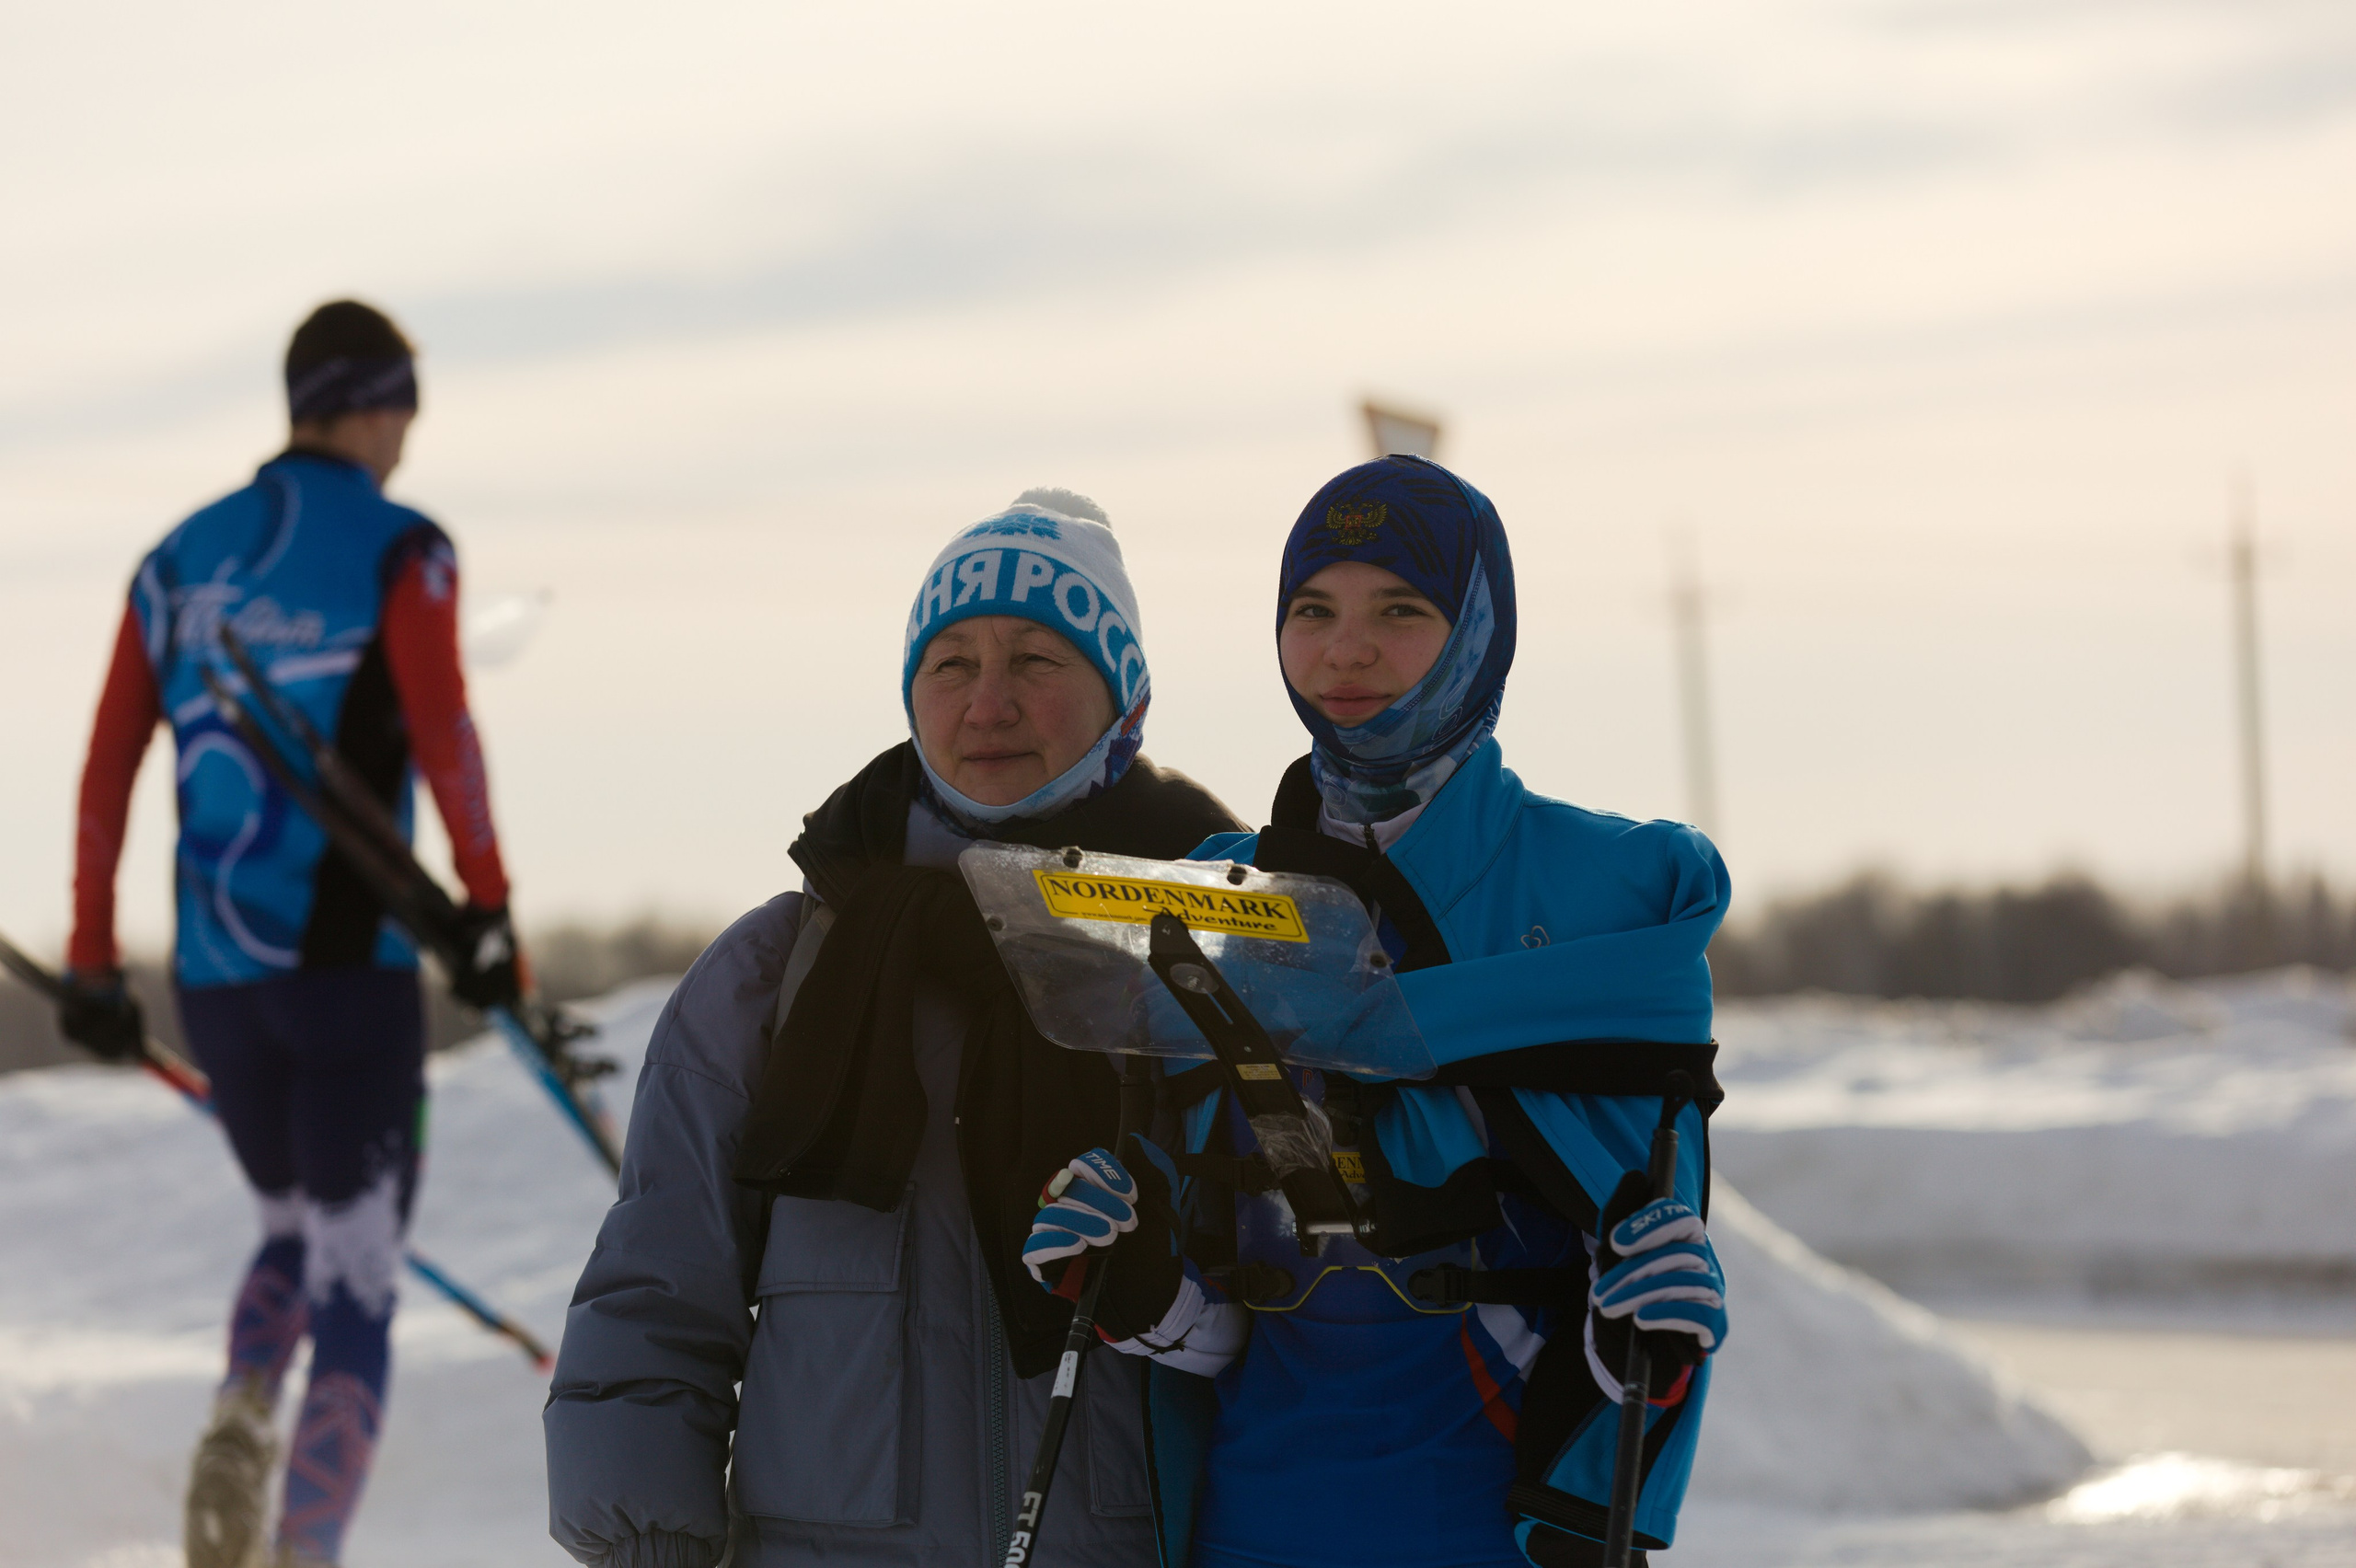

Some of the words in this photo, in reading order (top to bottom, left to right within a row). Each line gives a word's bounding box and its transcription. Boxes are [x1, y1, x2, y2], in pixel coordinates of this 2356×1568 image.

[1011, 552, 1148, 707] РОСС
[1050, 878, 1287, 920] NORDENMARK
[1086, 1153, 1122, 1181] TIME
[1630, 1208, 1662, 1235] SKI
[1018, 1492, 1042, 1528] FT
